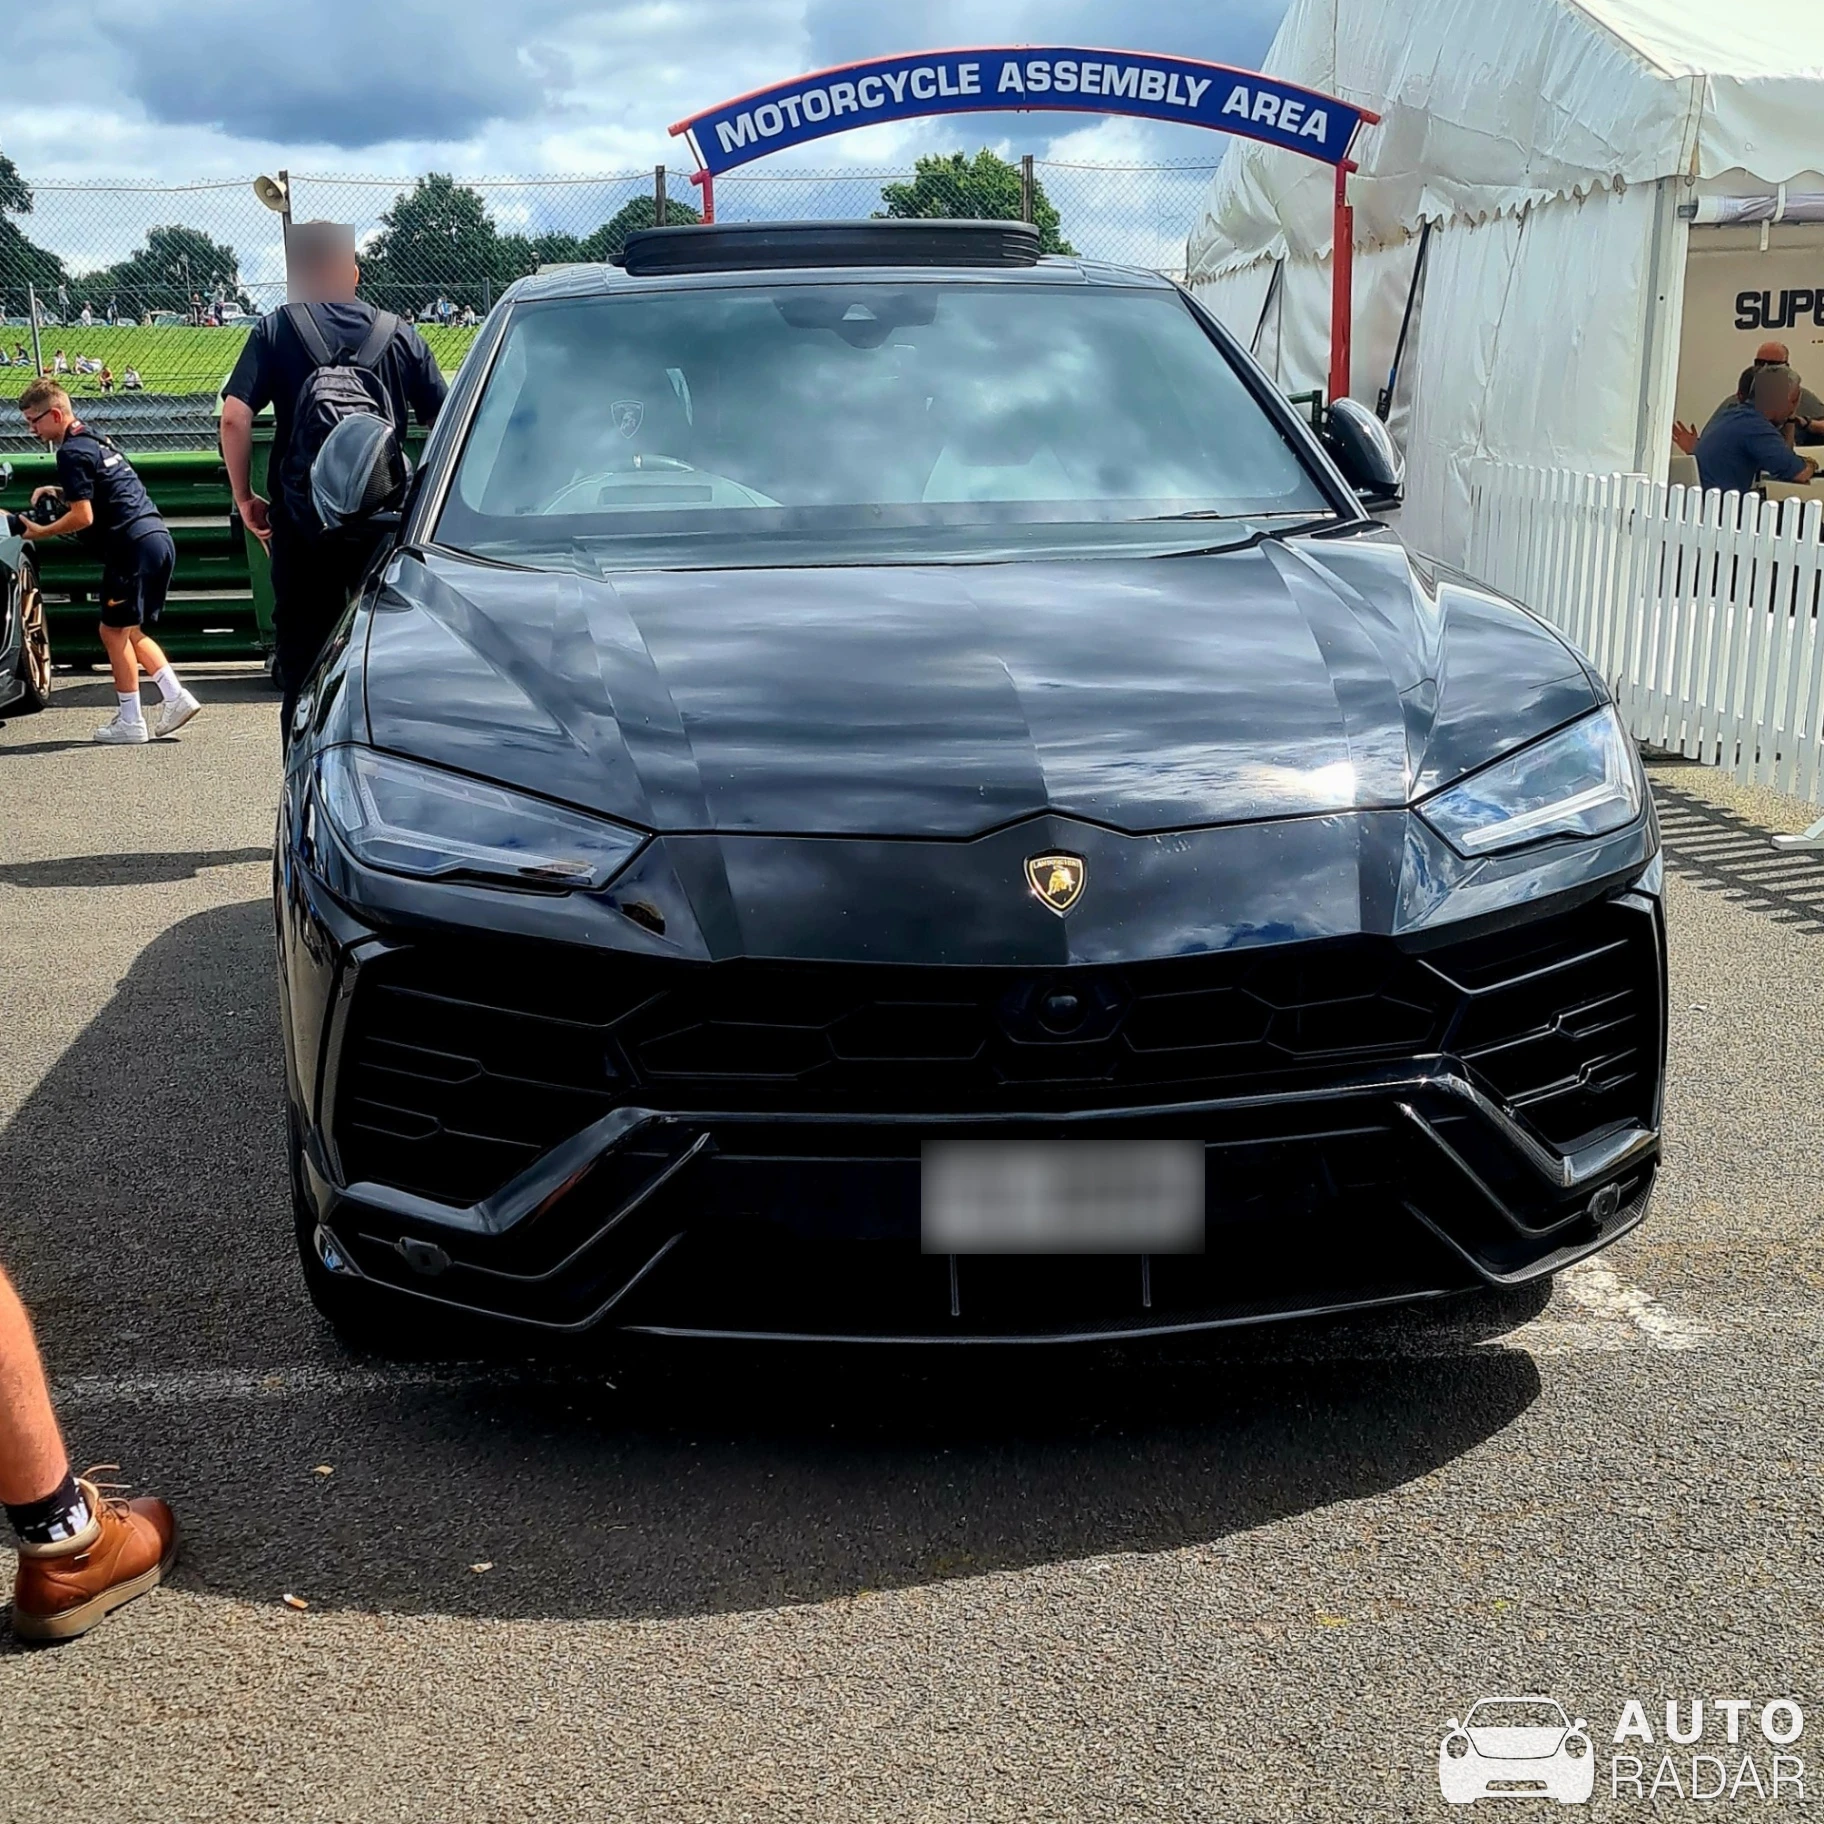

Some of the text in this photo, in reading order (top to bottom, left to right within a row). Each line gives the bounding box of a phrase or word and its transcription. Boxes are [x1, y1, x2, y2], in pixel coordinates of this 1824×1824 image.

[715, 60, 1329, 153] MOTORCYCLE ASSEMBLY AREA
